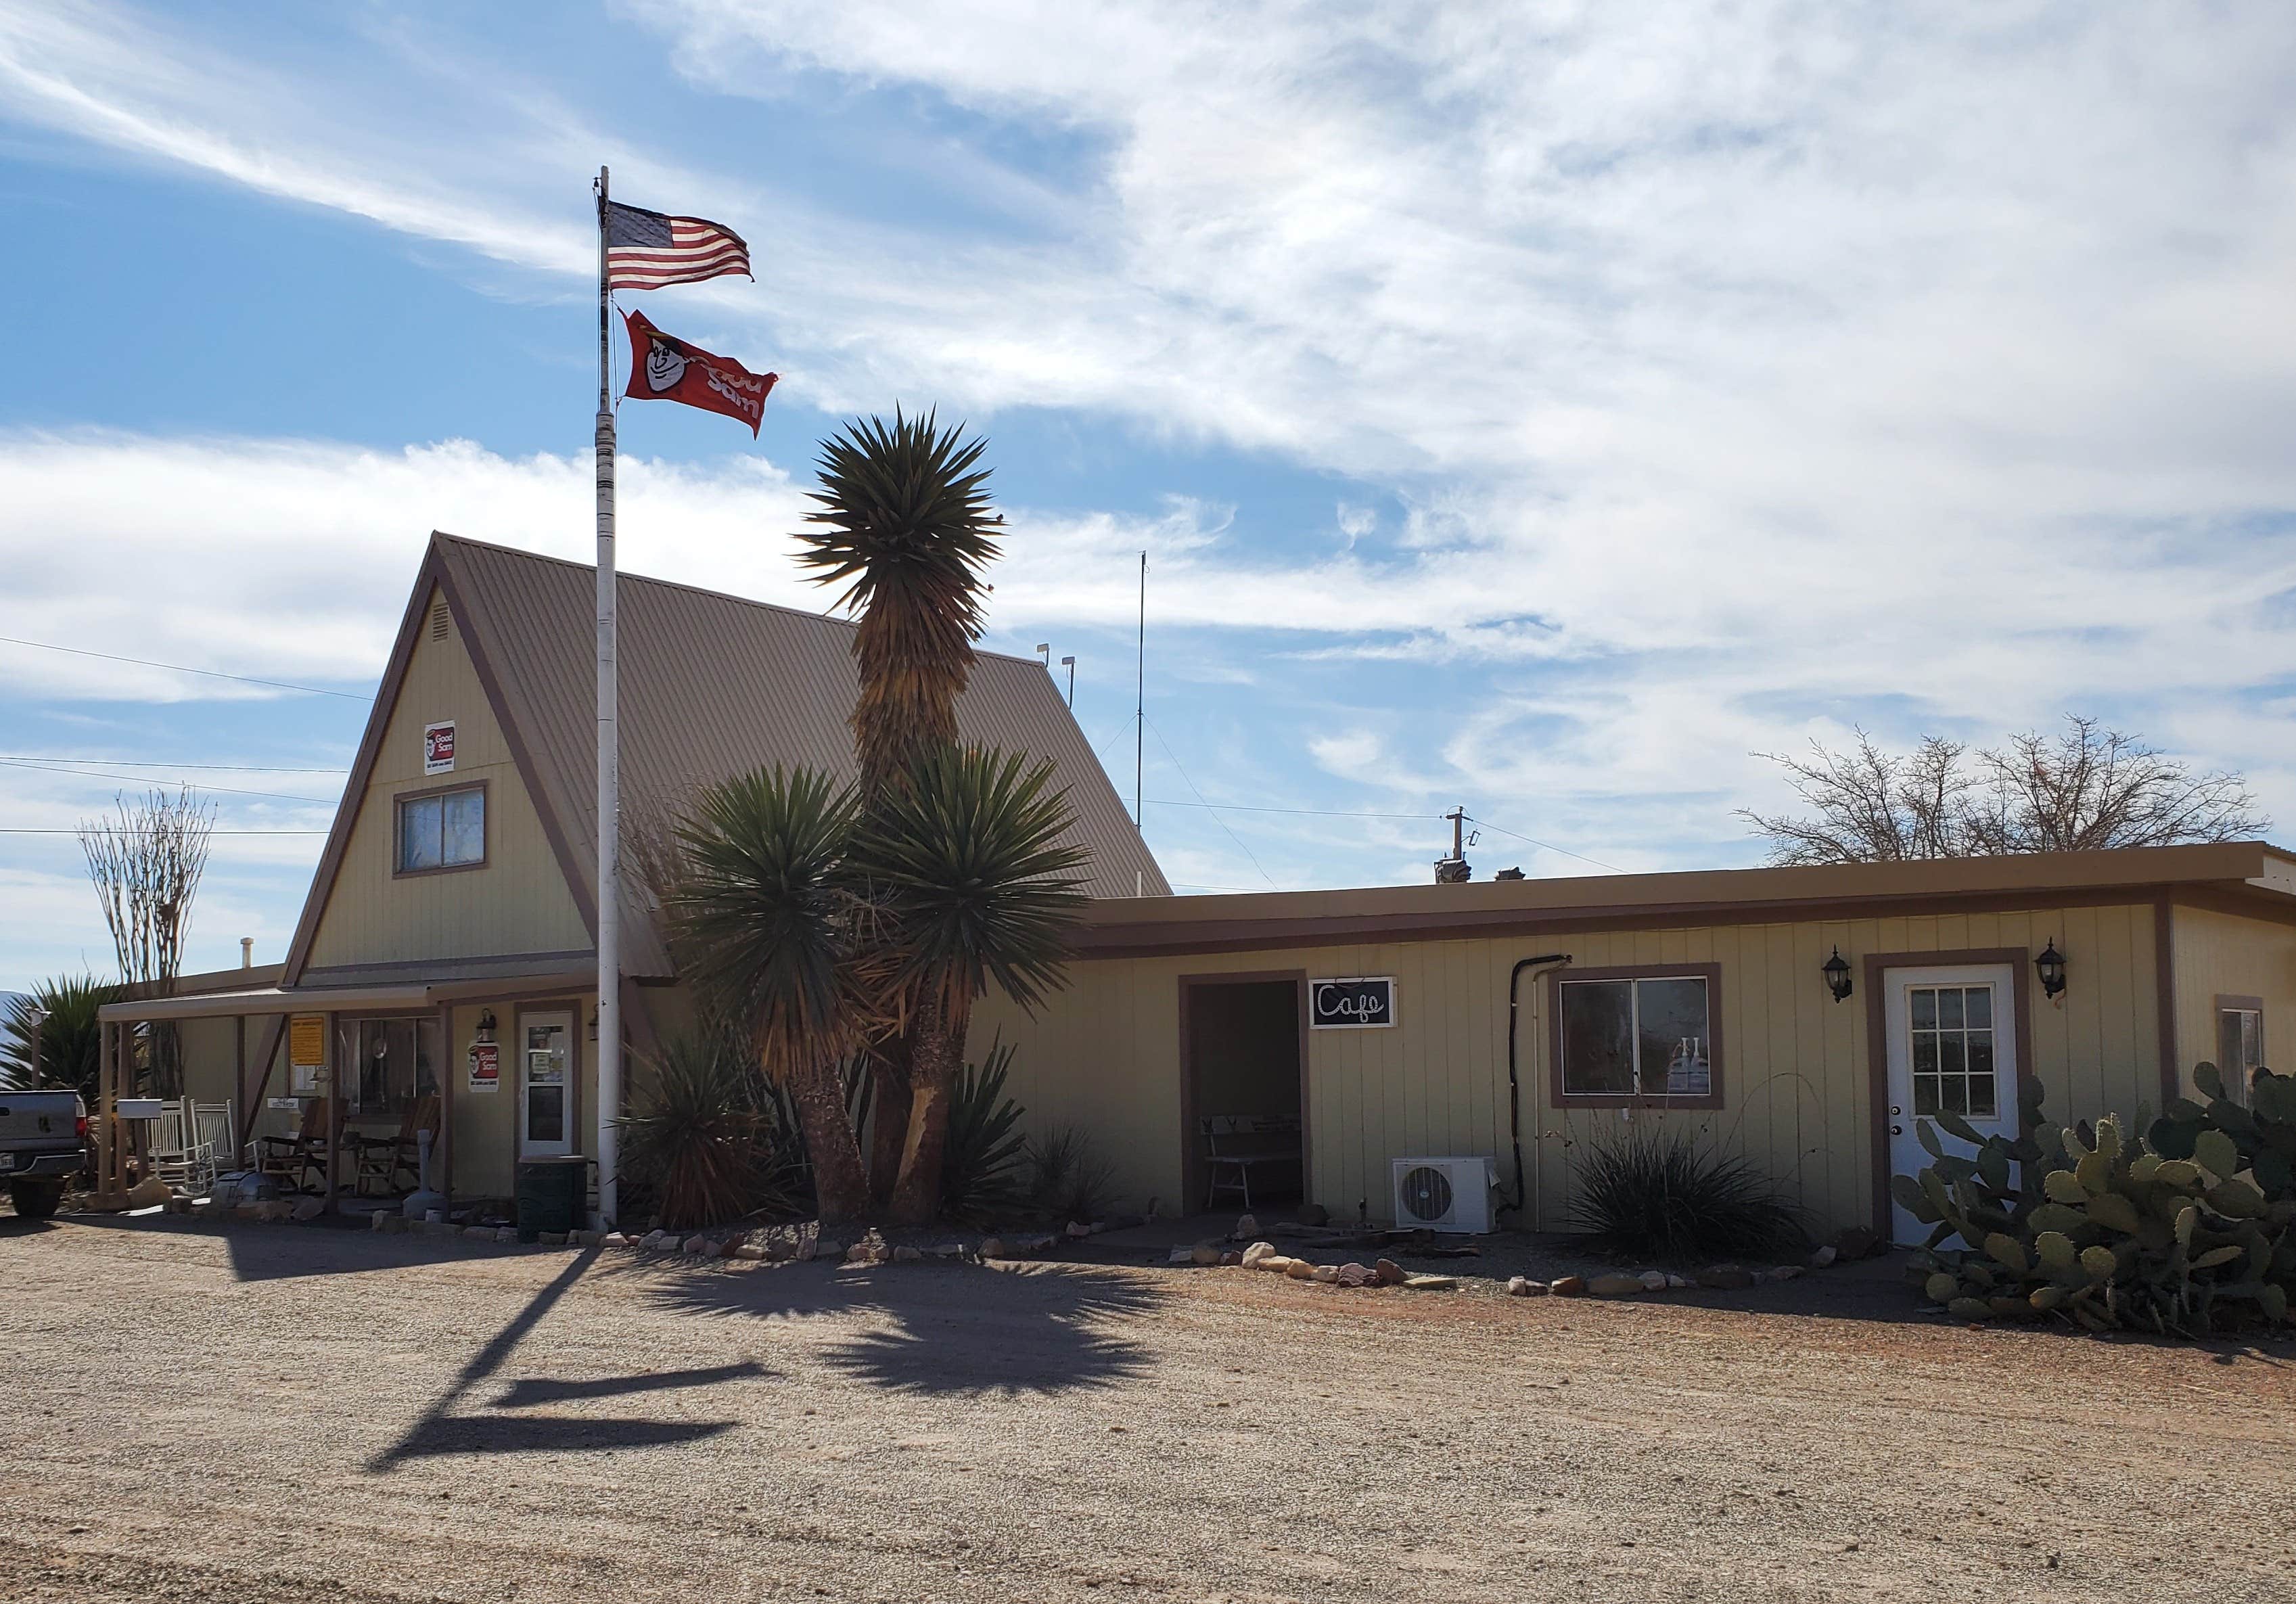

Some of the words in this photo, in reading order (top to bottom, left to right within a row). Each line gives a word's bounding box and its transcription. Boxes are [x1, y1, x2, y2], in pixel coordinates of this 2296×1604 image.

[708, 369, 760, 419] Sam
[435, 732, 453, 743] Good
[438, 743, 453, 752] Sam
[1318, 984, 1385, 1023] Cafe
[480, 1052, 497, 1061] Good
[482, 1061, 497, 1070] Sam
